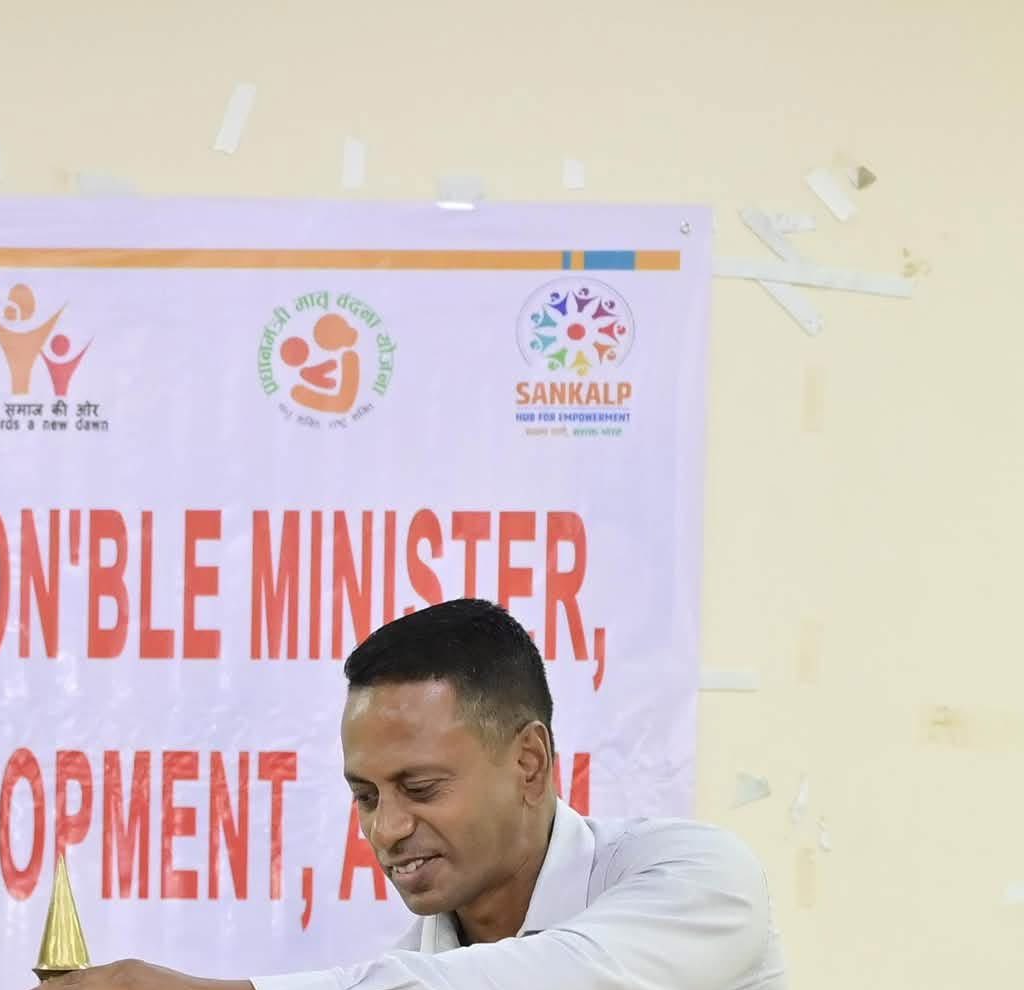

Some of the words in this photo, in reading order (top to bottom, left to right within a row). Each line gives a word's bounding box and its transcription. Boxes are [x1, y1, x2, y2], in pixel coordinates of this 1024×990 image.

[516, 381, 632, 405] SANKALP
[4, 402, 43, 417] समाज
[52, 399, 68, 417] की
[77, 400, 100, 417] ओर
[27, 421, 35, 431] a
[42, 421, 68, 431] new
[75, 417, 109, 431] dawn
[515, 412, 535, 422] HUB
[538, 412, 556, 422] FOR
[558, 412, 631, 423] EMPOWERMENT
[250, 508, 606, 692] MINISTER,
